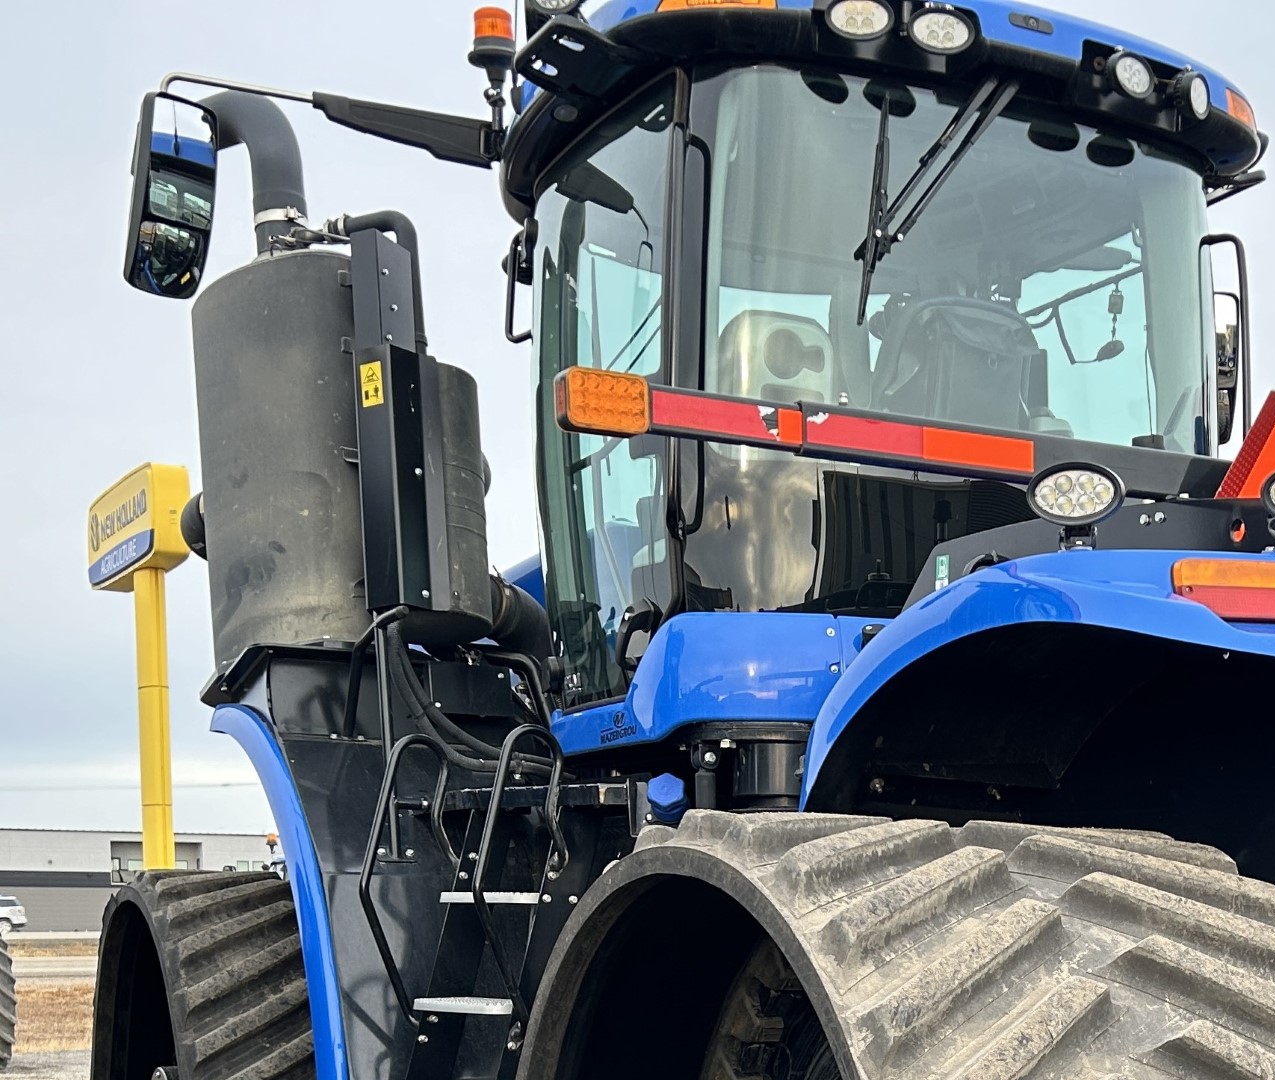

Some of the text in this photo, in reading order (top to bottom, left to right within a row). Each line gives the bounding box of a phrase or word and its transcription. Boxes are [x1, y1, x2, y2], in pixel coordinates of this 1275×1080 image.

[101, 512, 115, 542] NEW
[116, 489, 146, 530] HOLLAND
[101, 538, 137, 575] AGRICULTURE
